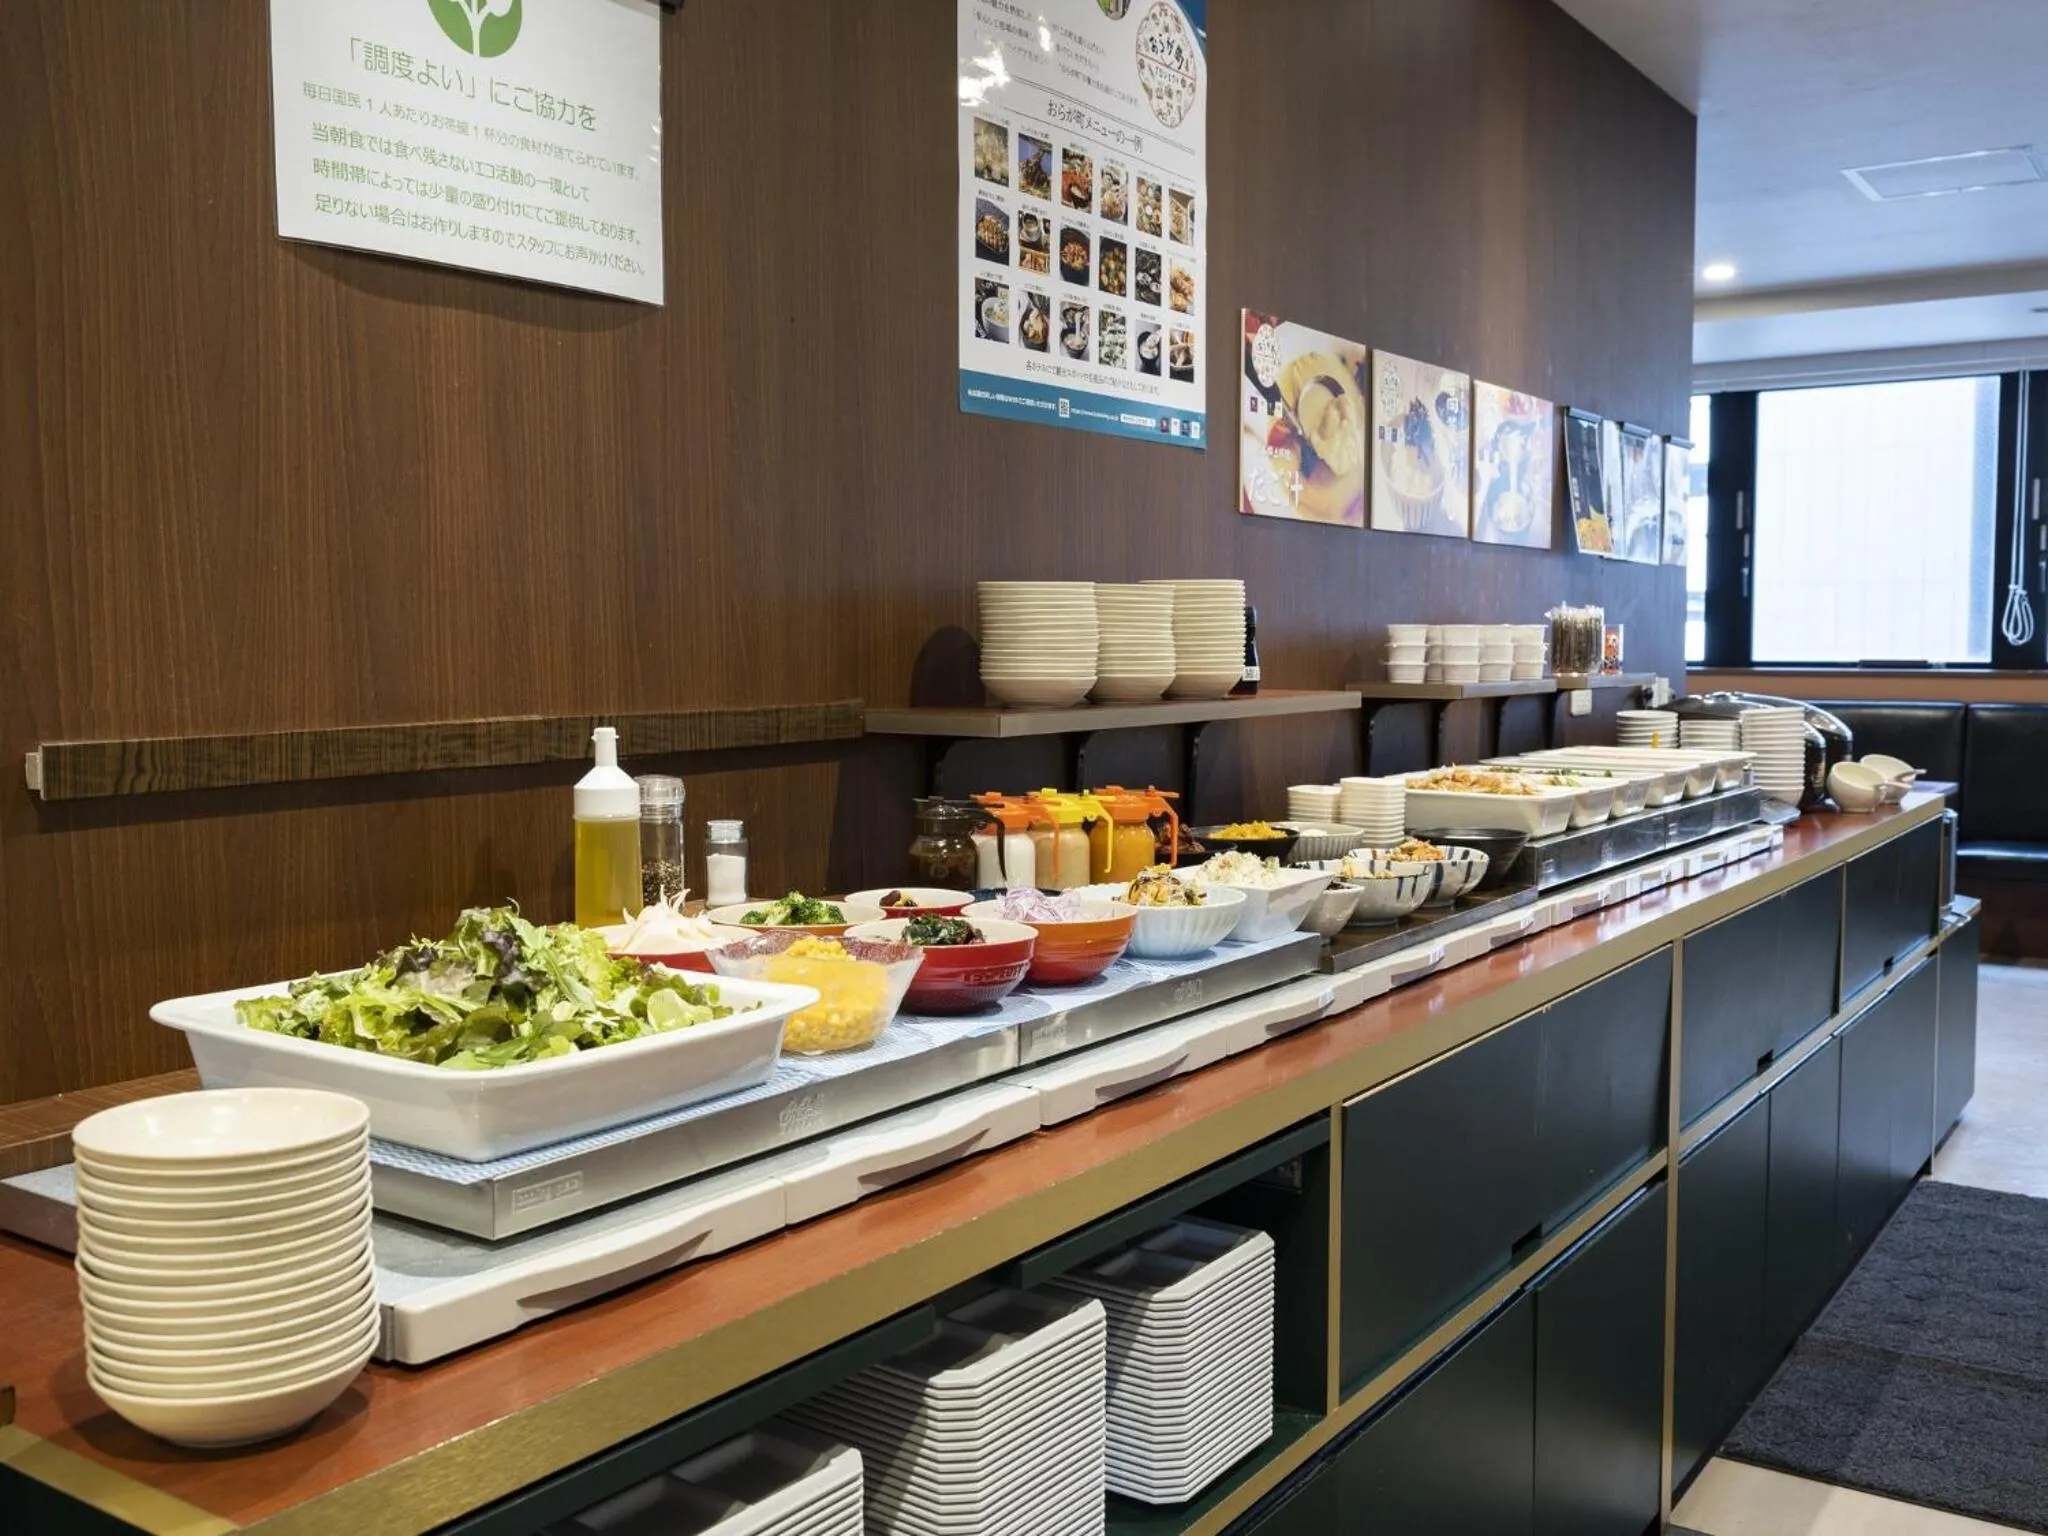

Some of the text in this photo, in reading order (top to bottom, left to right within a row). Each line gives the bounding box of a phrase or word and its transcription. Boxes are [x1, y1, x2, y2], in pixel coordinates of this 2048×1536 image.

[350, 37, 597, 132] 「調度よい」にご協力を
[312, 122, 590, 203] 当朝食では食べ残さないエコ活動の一環として
[313, 157, 641, 246] 時間帯によっては少量の盛り付けにてご提供しております。
